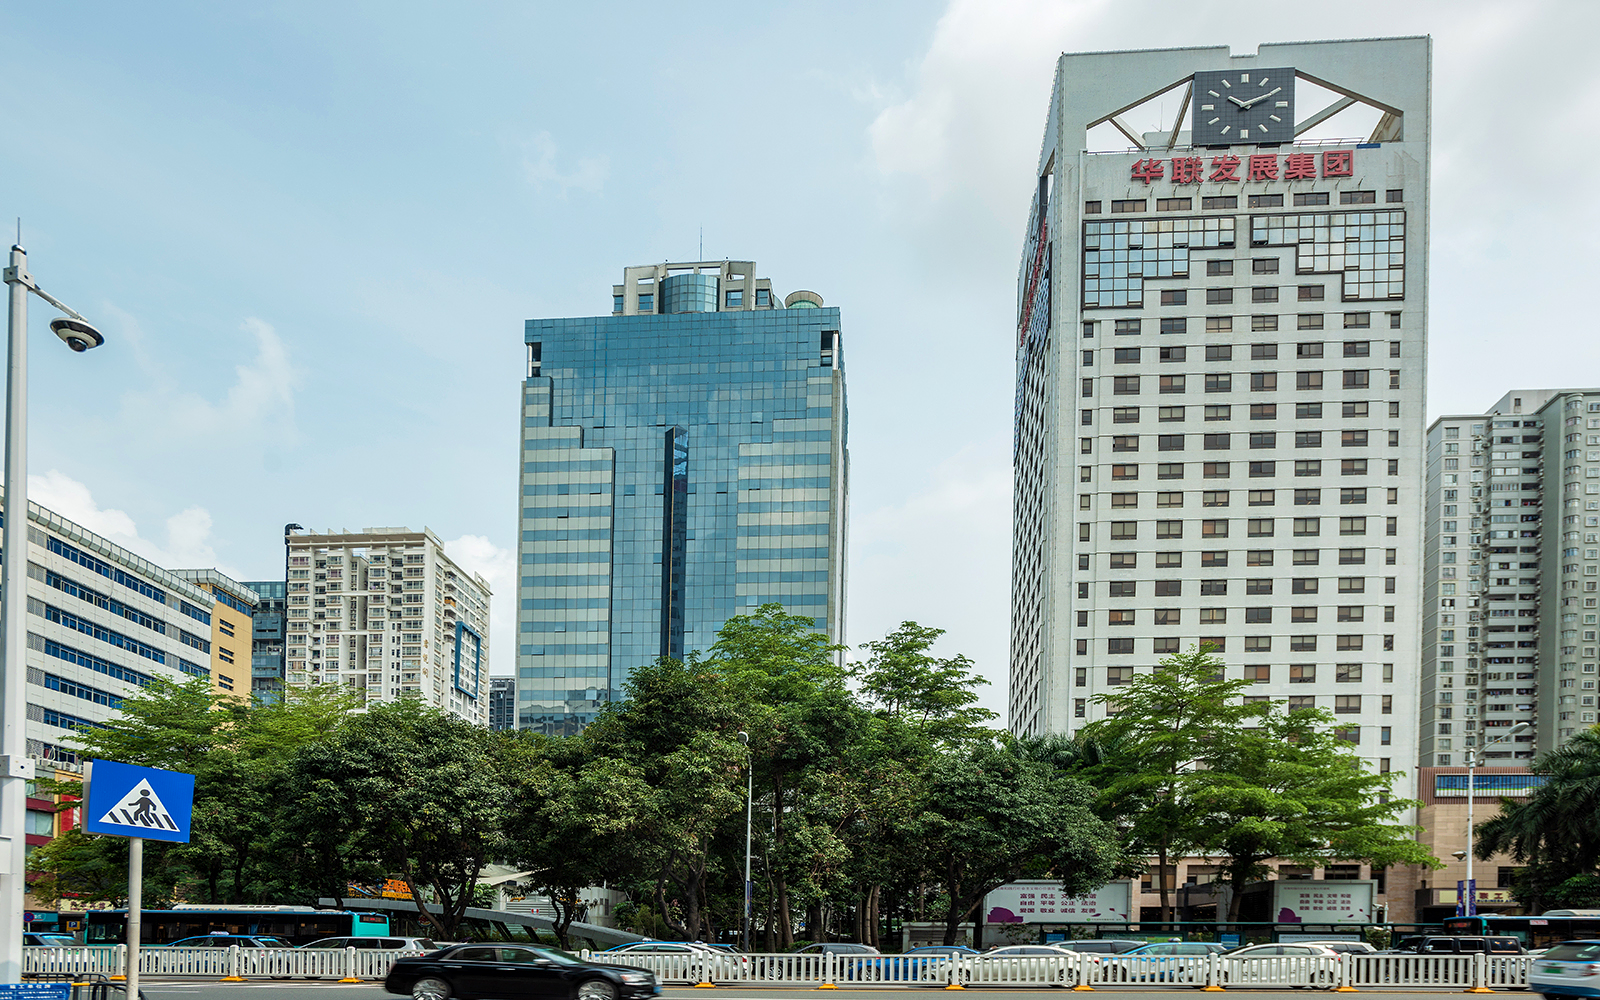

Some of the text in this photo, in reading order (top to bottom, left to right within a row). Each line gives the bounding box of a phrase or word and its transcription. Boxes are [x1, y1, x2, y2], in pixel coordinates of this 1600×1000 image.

[1131, 149, 1354, 184] 华联发展集团
